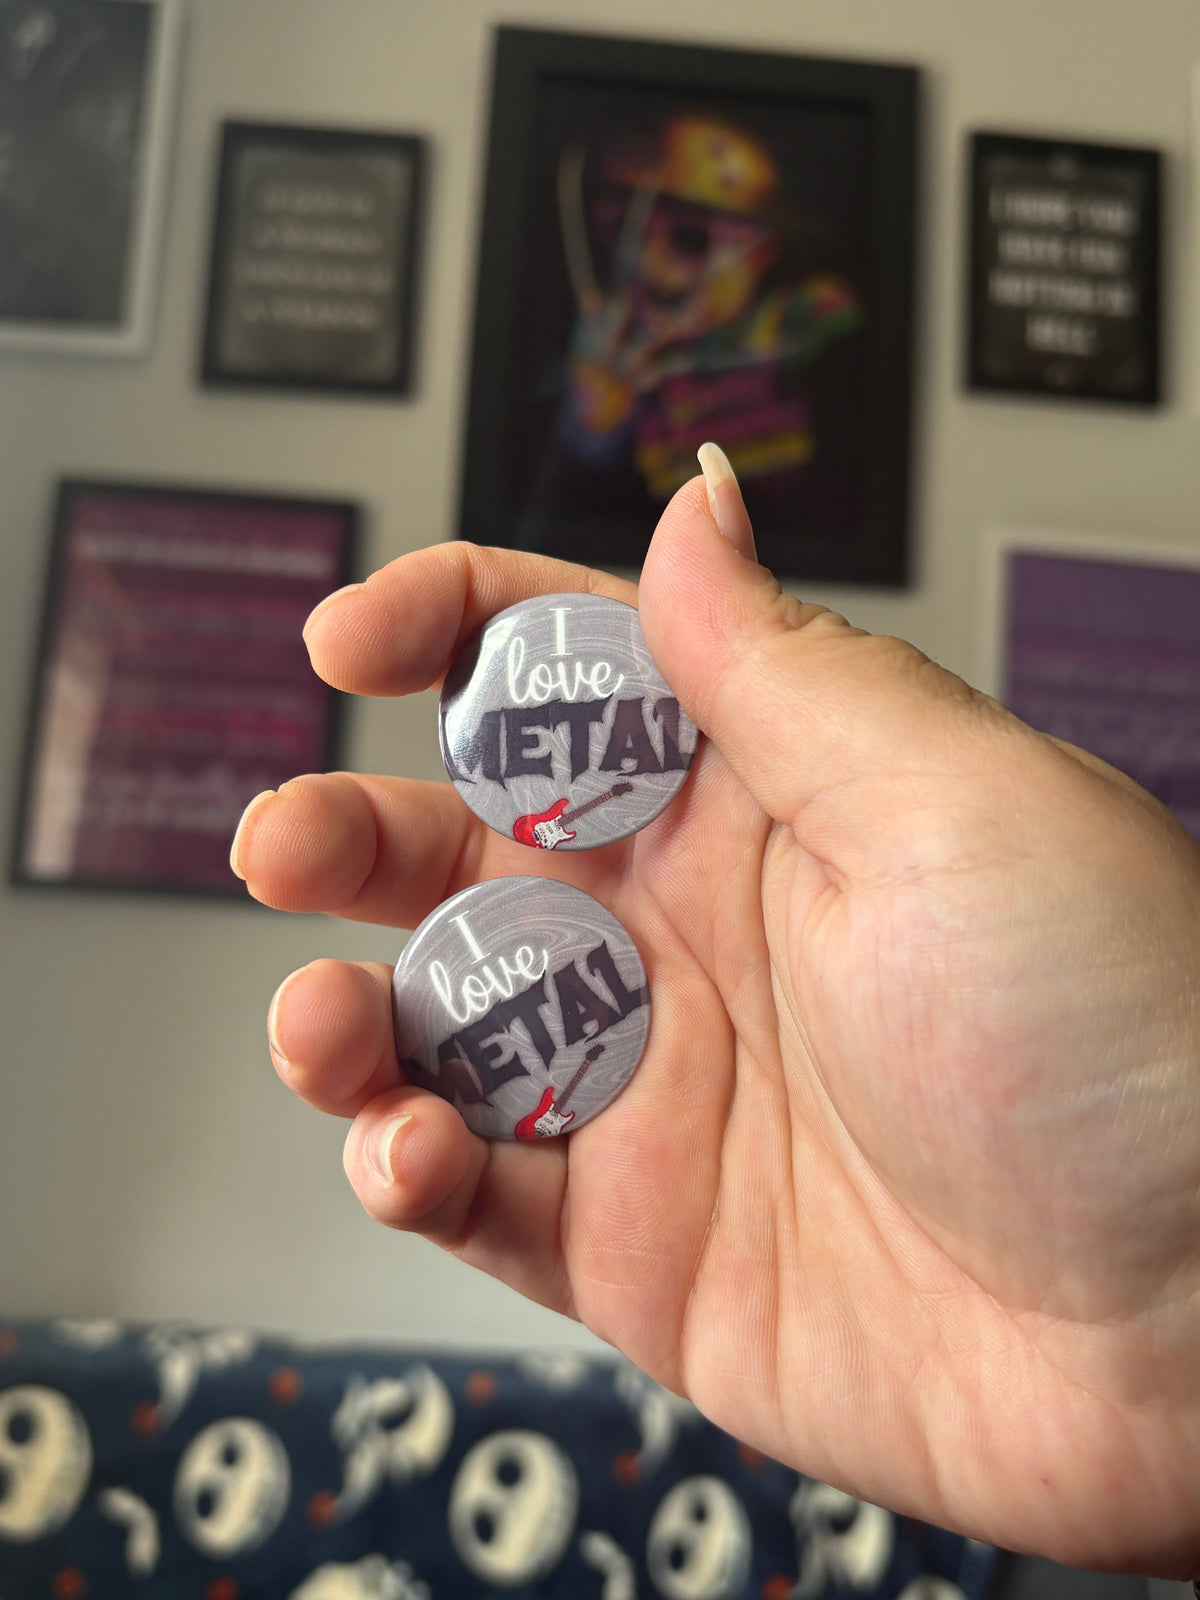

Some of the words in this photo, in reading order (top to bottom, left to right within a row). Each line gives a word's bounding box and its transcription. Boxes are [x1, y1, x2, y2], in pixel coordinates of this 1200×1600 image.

[549, 608, 572, 656] I
[507, 637, 624, 703] love
[449, 911, 491, 965] I
[430, 946, 548, 1023] love
